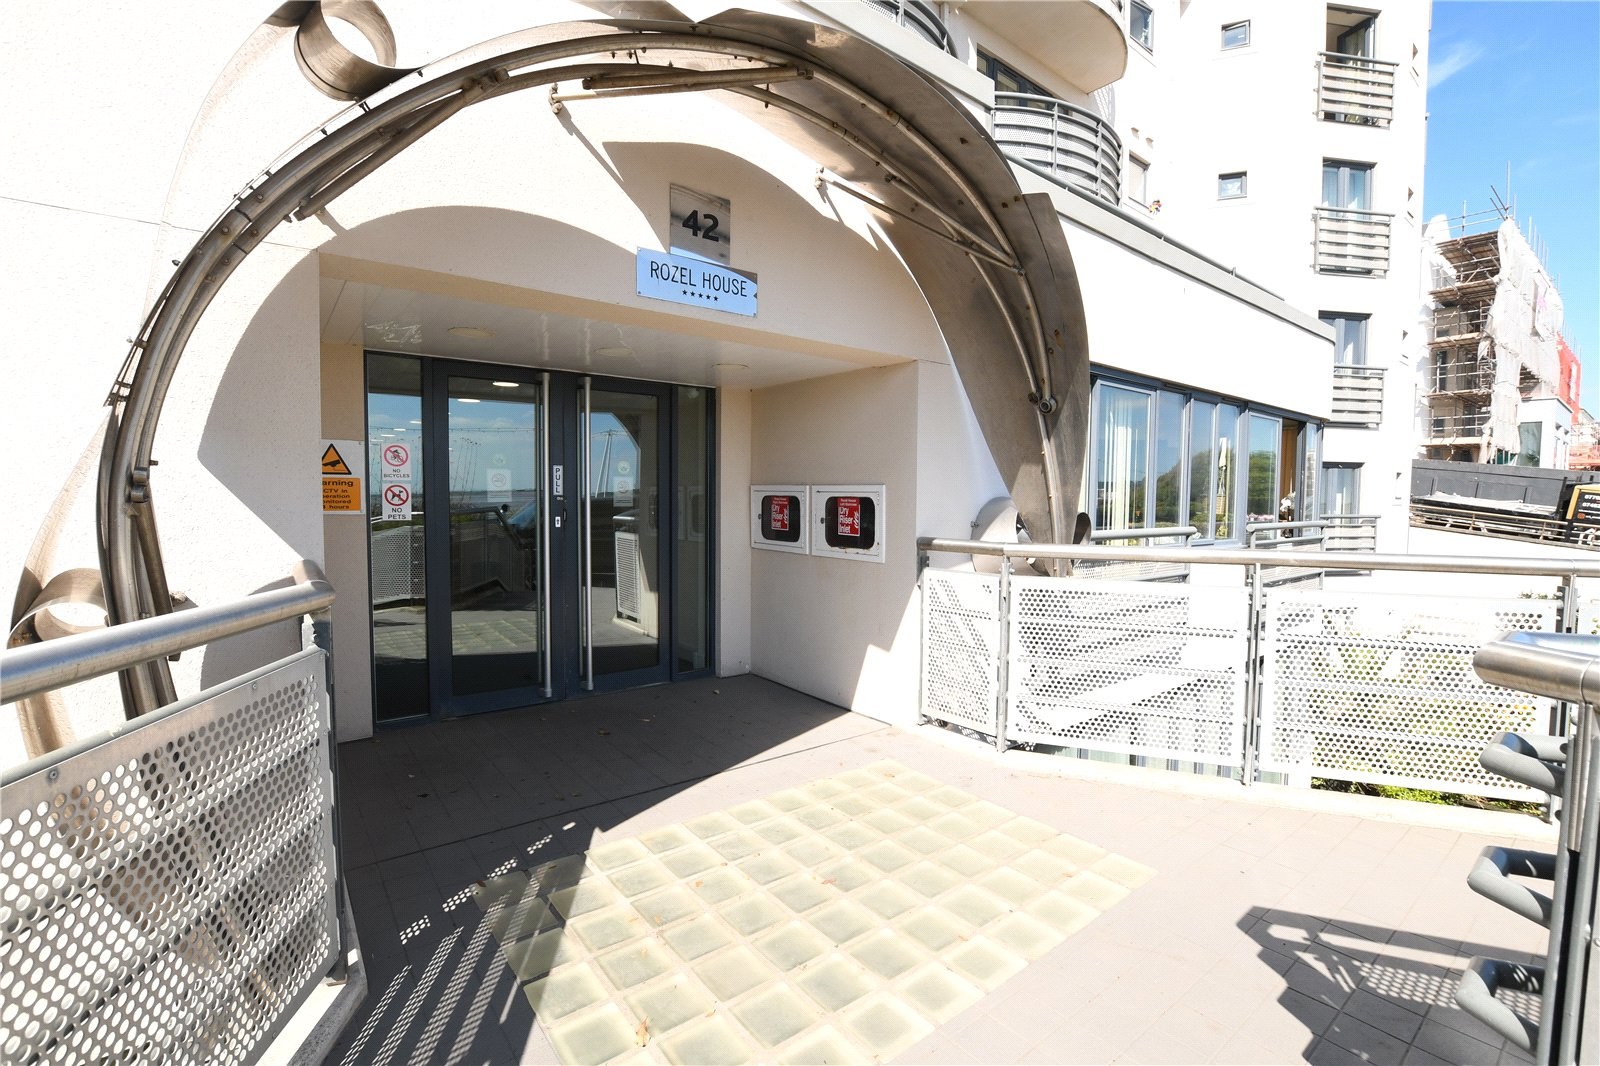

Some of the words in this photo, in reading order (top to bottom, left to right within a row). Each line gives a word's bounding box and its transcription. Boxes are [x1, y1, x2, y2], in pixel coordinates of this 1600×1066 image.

[682, 210, 719, 242] 42
[650, 260, 697, 287] ROZEL
[702, 271, 748, 298] HOUSE
